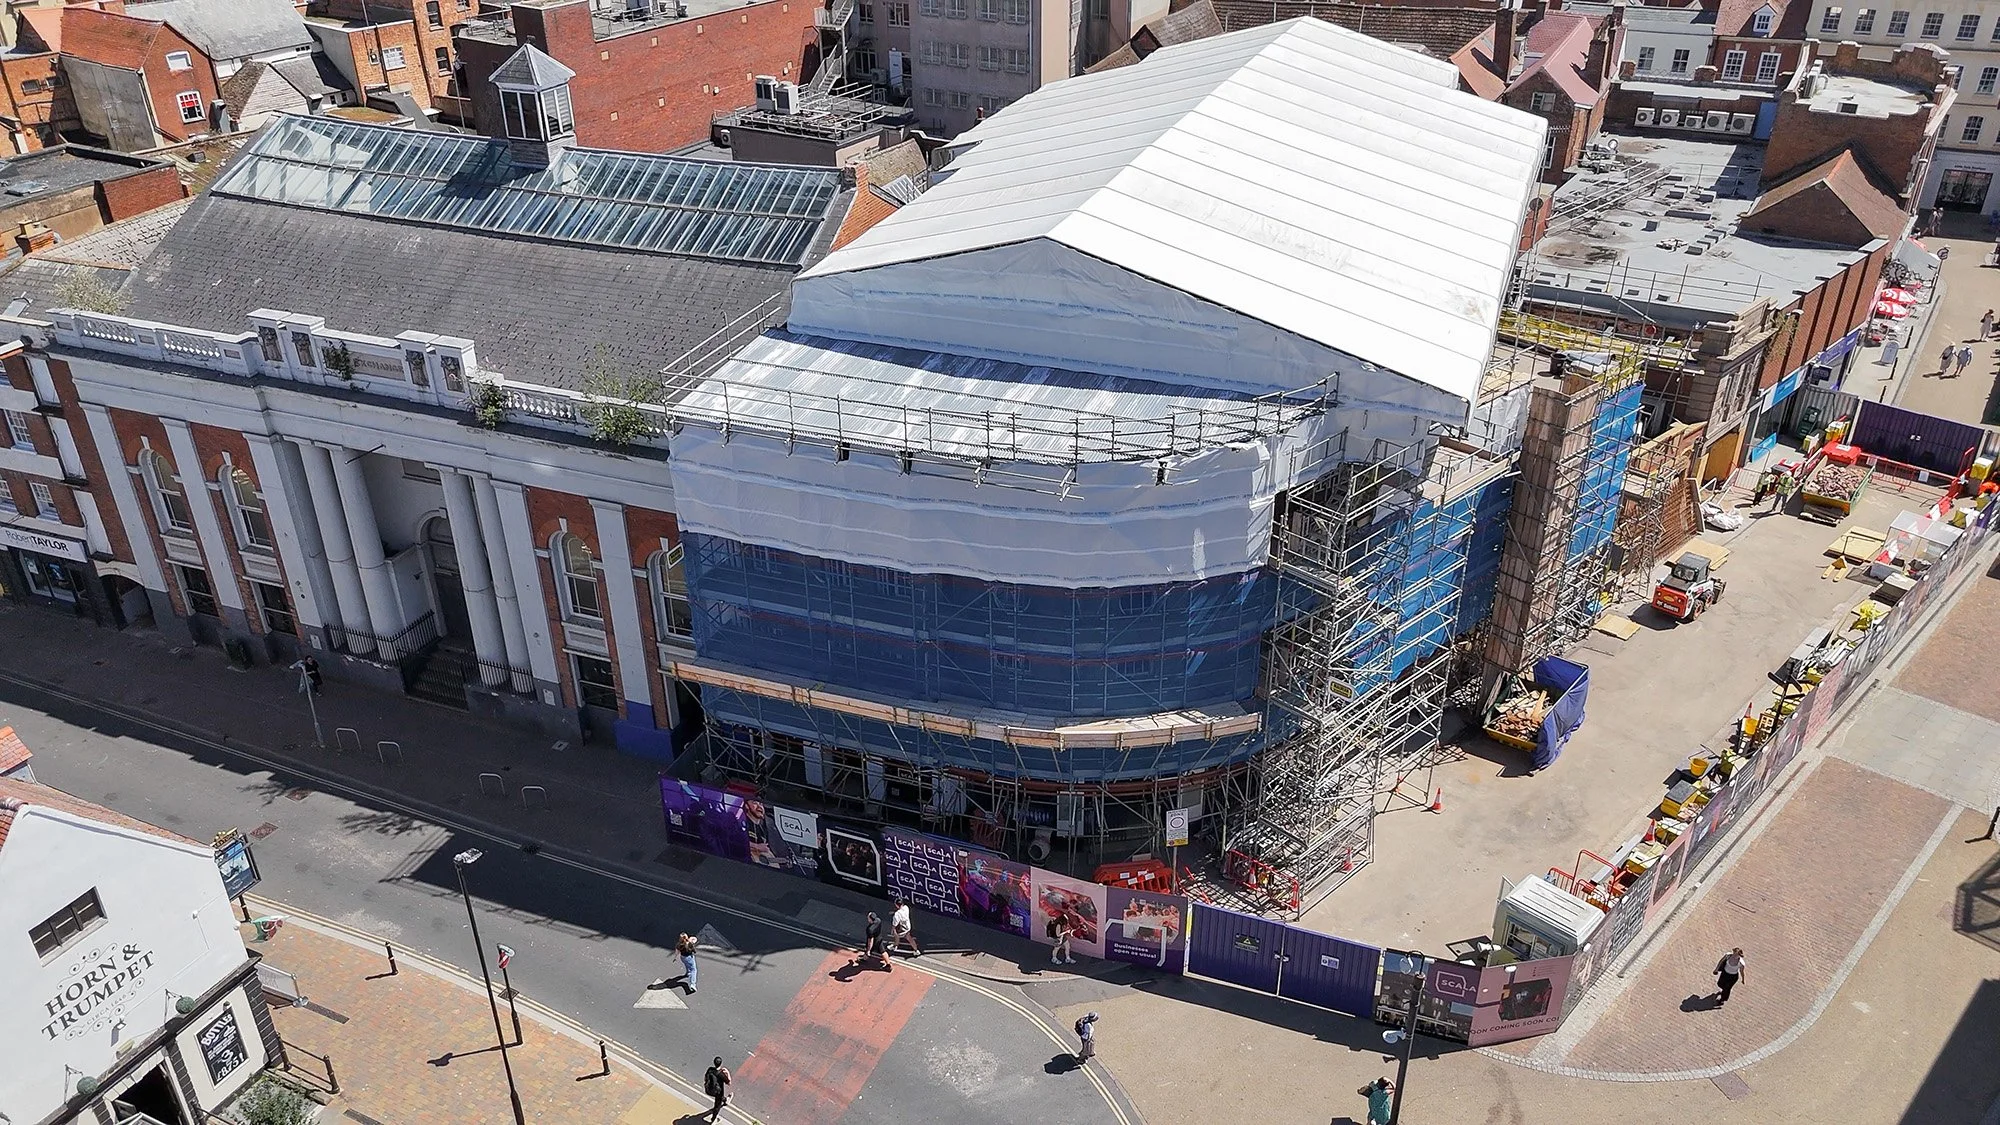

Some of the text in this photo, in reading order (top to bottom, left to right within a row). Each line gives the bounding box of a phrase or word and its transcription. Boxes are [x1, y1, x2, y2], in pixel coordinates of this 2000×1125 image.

[784, 821, 811, 834] SCALA
[898, 840, 951, 858] SCALA SCALA
[913, 861, 937, 873] SCALA
[900, 876, 952, 895] SCALA SCALA
[915, 898, 939, 909] SCALA
[1114, 943, 1148, 952] Businesses
[44, 943, 141, 1018] HORN &
[1441, 979, 1477, 993] SCALA
[41, 950, 154, 1041] TRUMPET
[87, 1007, 110, 1025] CIRCA
[201, 1014, 233, 1046] BOTTLES
[1489, 1022, 1520, 1032] COMING
[1522, 1018, 1544, 1027] SOON
